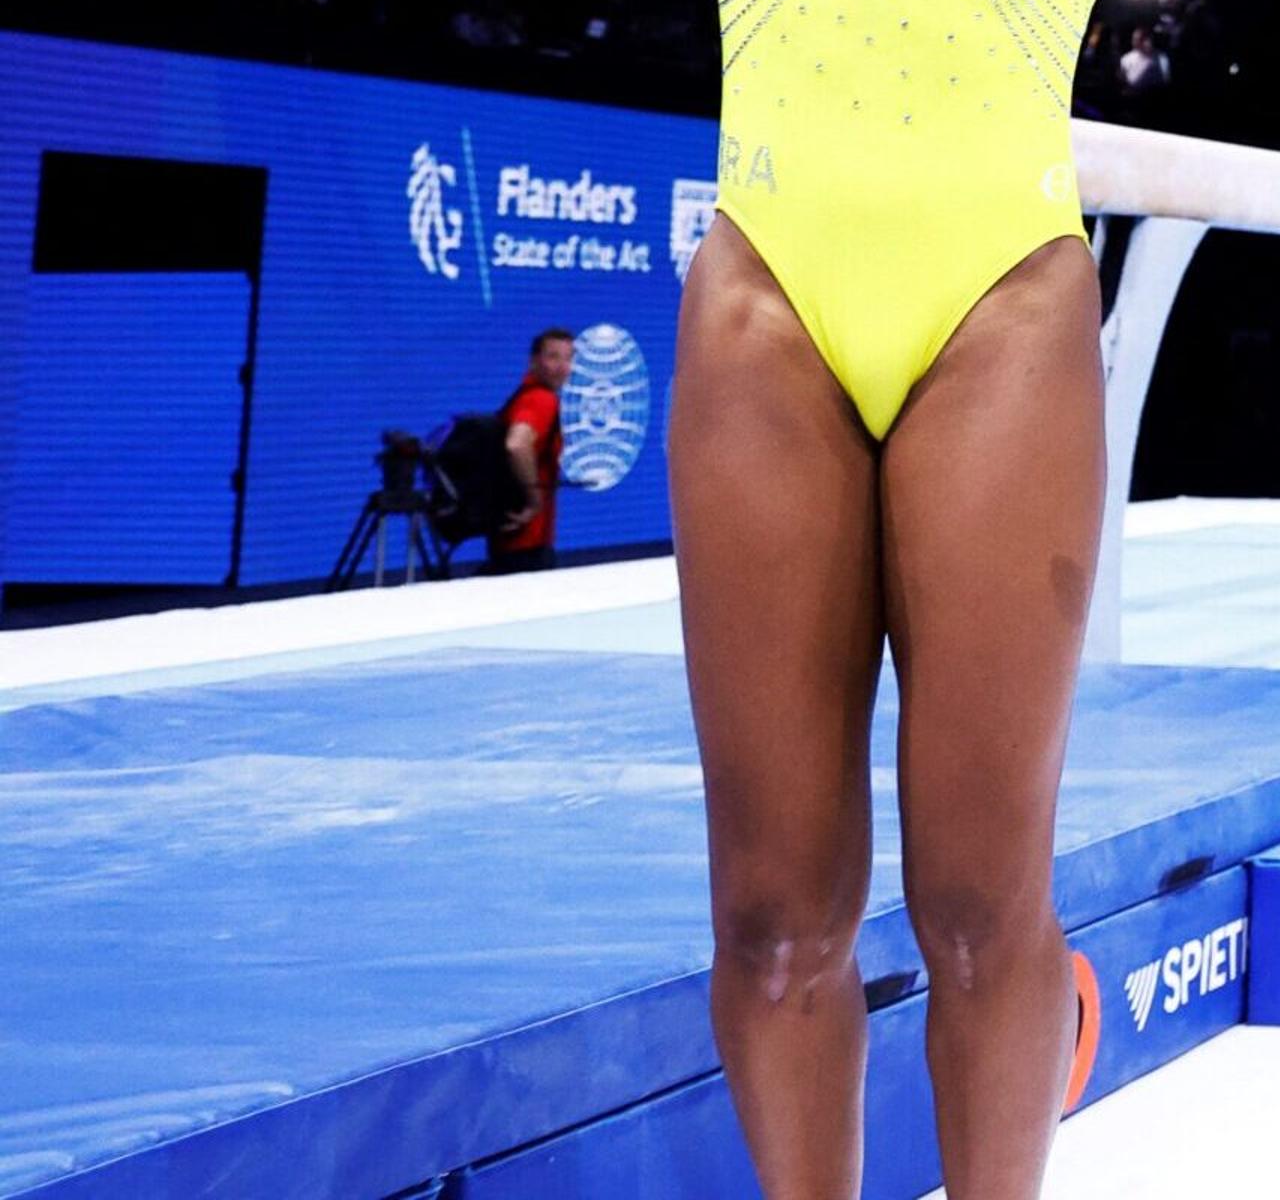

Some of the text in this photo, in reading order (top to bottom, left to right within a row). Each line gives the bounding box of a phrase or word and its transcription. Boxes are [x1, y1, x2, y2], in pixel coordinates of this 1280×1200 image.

[718, 130, 778, 193] RA
[497, 164, 637, 225] Flanders
[492, 233, 550, 268] State
[552, 235, 580, 269] of
[580, 238, 616, 270] the
